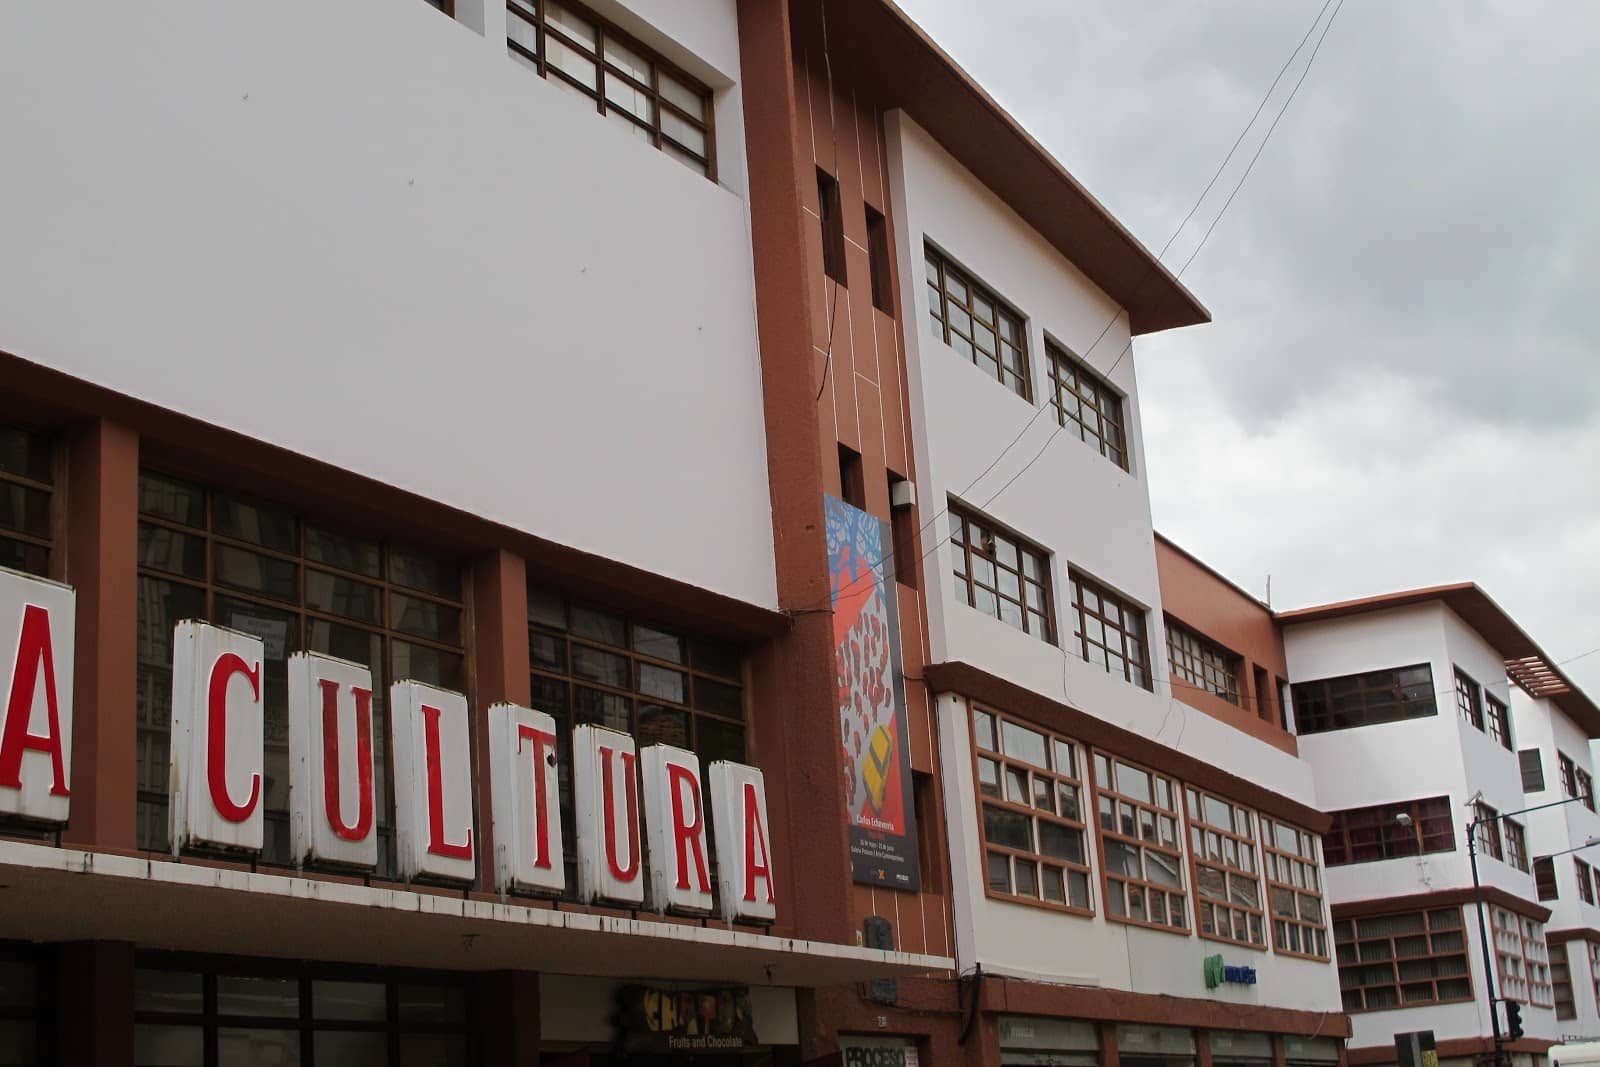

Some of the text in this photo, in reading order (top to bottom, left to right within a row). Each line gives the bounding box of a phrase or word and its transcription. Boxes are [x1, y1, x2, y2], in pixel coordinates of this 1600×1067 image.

[207, 652, 776, 904] CULTURA
[669, 1034, 743, 1048] Fruits and Chocolate
[846, 1047, 905, 1067] PROCESO
